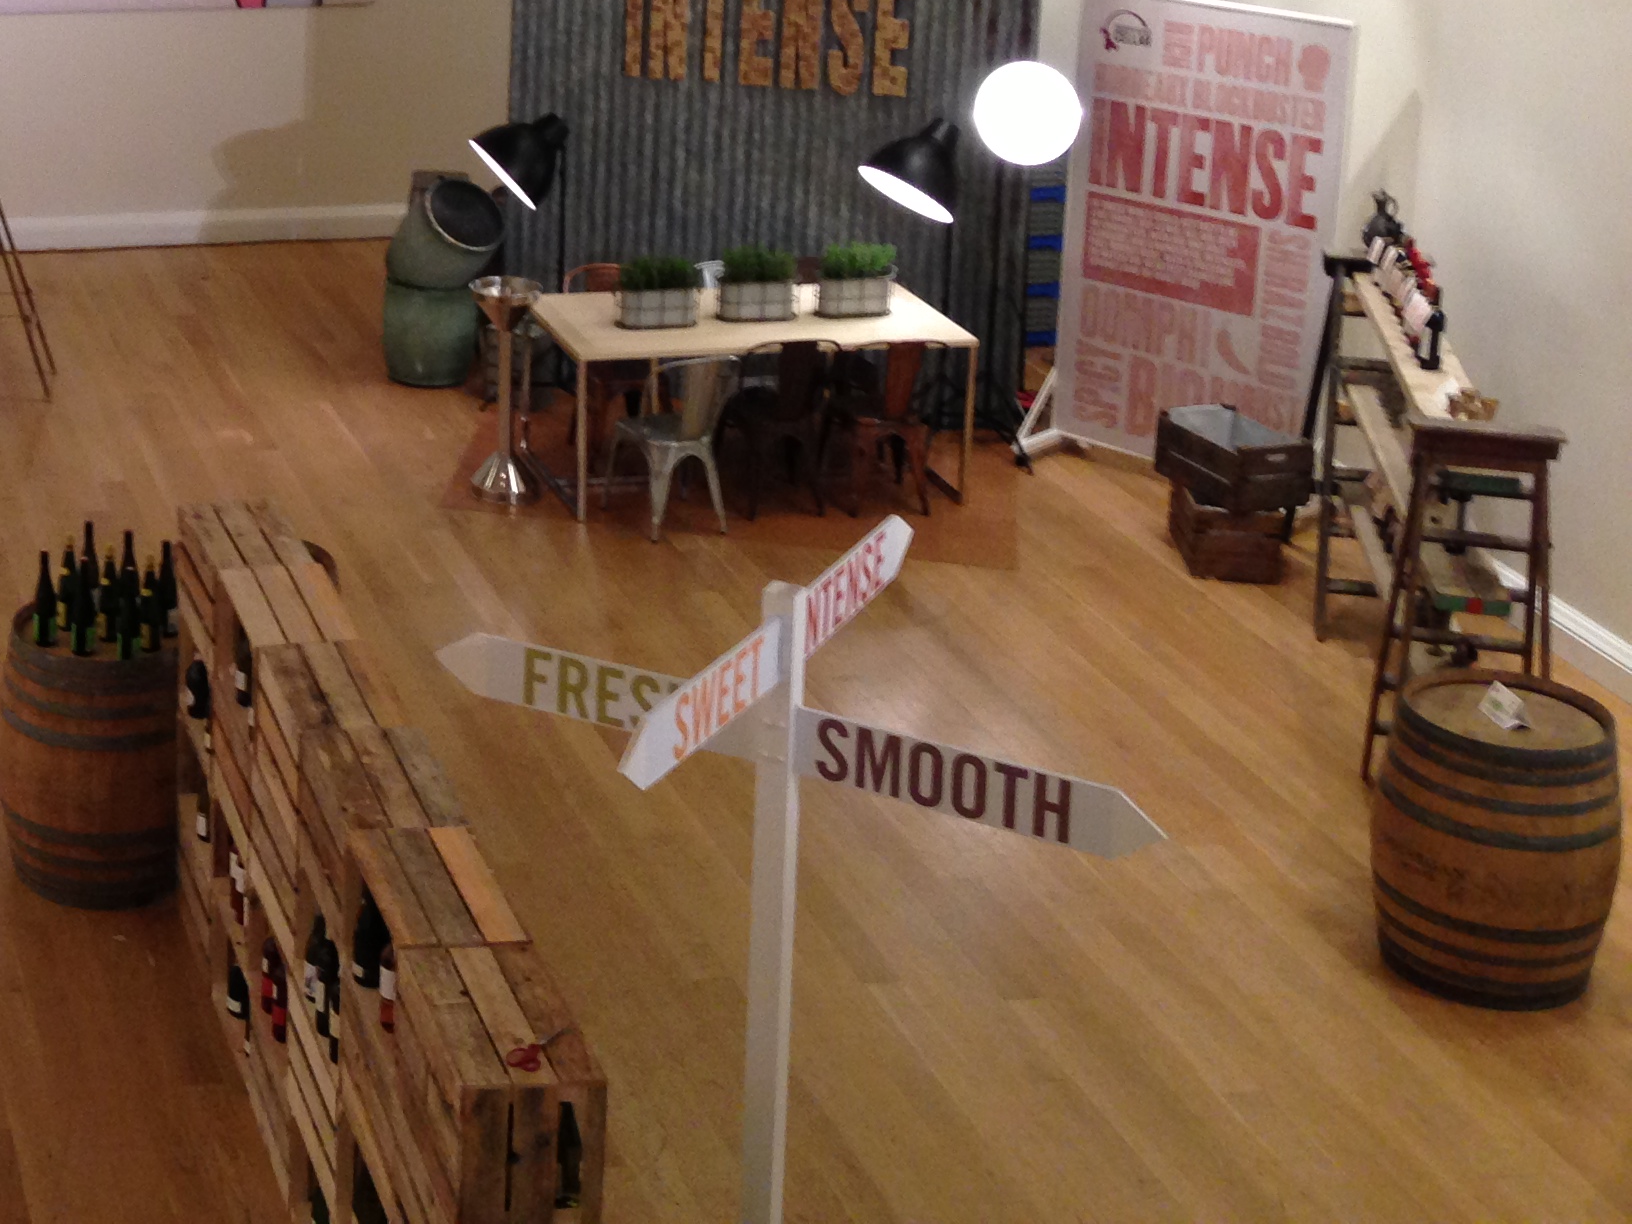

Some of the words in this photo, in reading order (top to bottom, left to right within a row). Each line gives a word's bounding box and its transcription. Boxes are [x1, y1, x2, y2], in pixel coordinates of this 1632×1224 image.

[1088, 96, 1324, 230] INTENSE
[805, 531, 886, 662] NTENSE
[521, 647, 680, 732] FRES
[673, 635, 765, 760] SWEET
[815, 718, 1070, 844] SMOOTH
